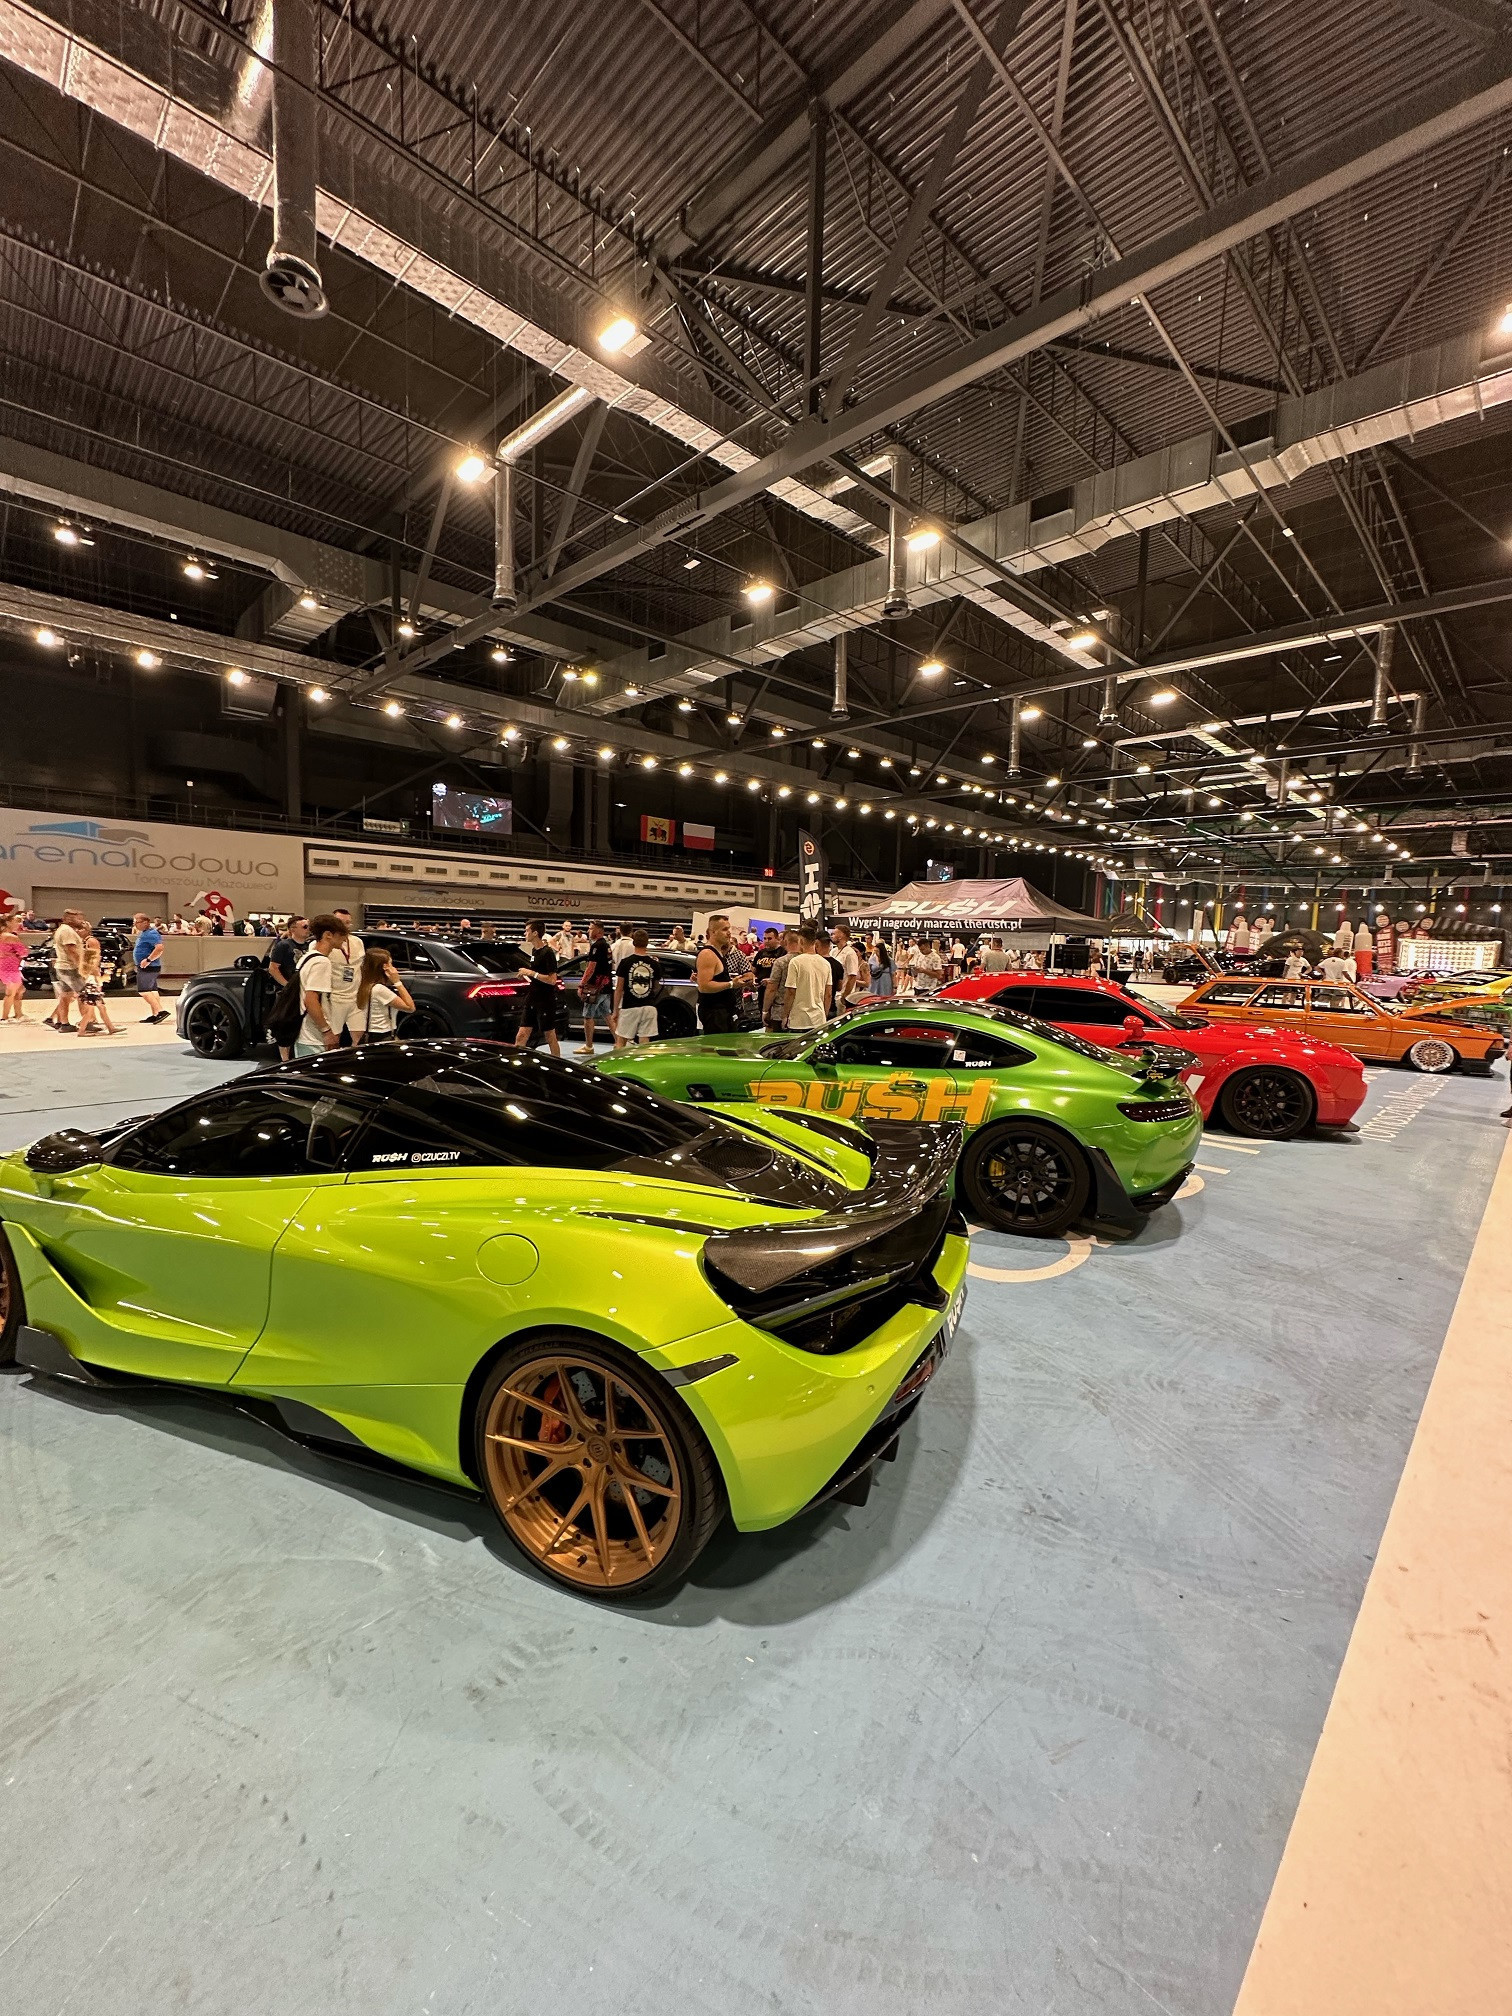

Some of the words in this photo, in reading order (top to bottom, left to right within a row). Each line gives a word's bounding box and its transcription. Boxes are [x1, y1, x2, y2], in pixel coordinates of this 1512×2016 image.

[134, 873, 204, 887] Tomaszów
[848, 917, 882, 929] Wygraj
[883, 918, 921, 930] nagrody
[923, 918, 961, 929] marzeń
[962, 918, 1022, 931] therush.pl
[839, 1081, 864, 1091] THE
